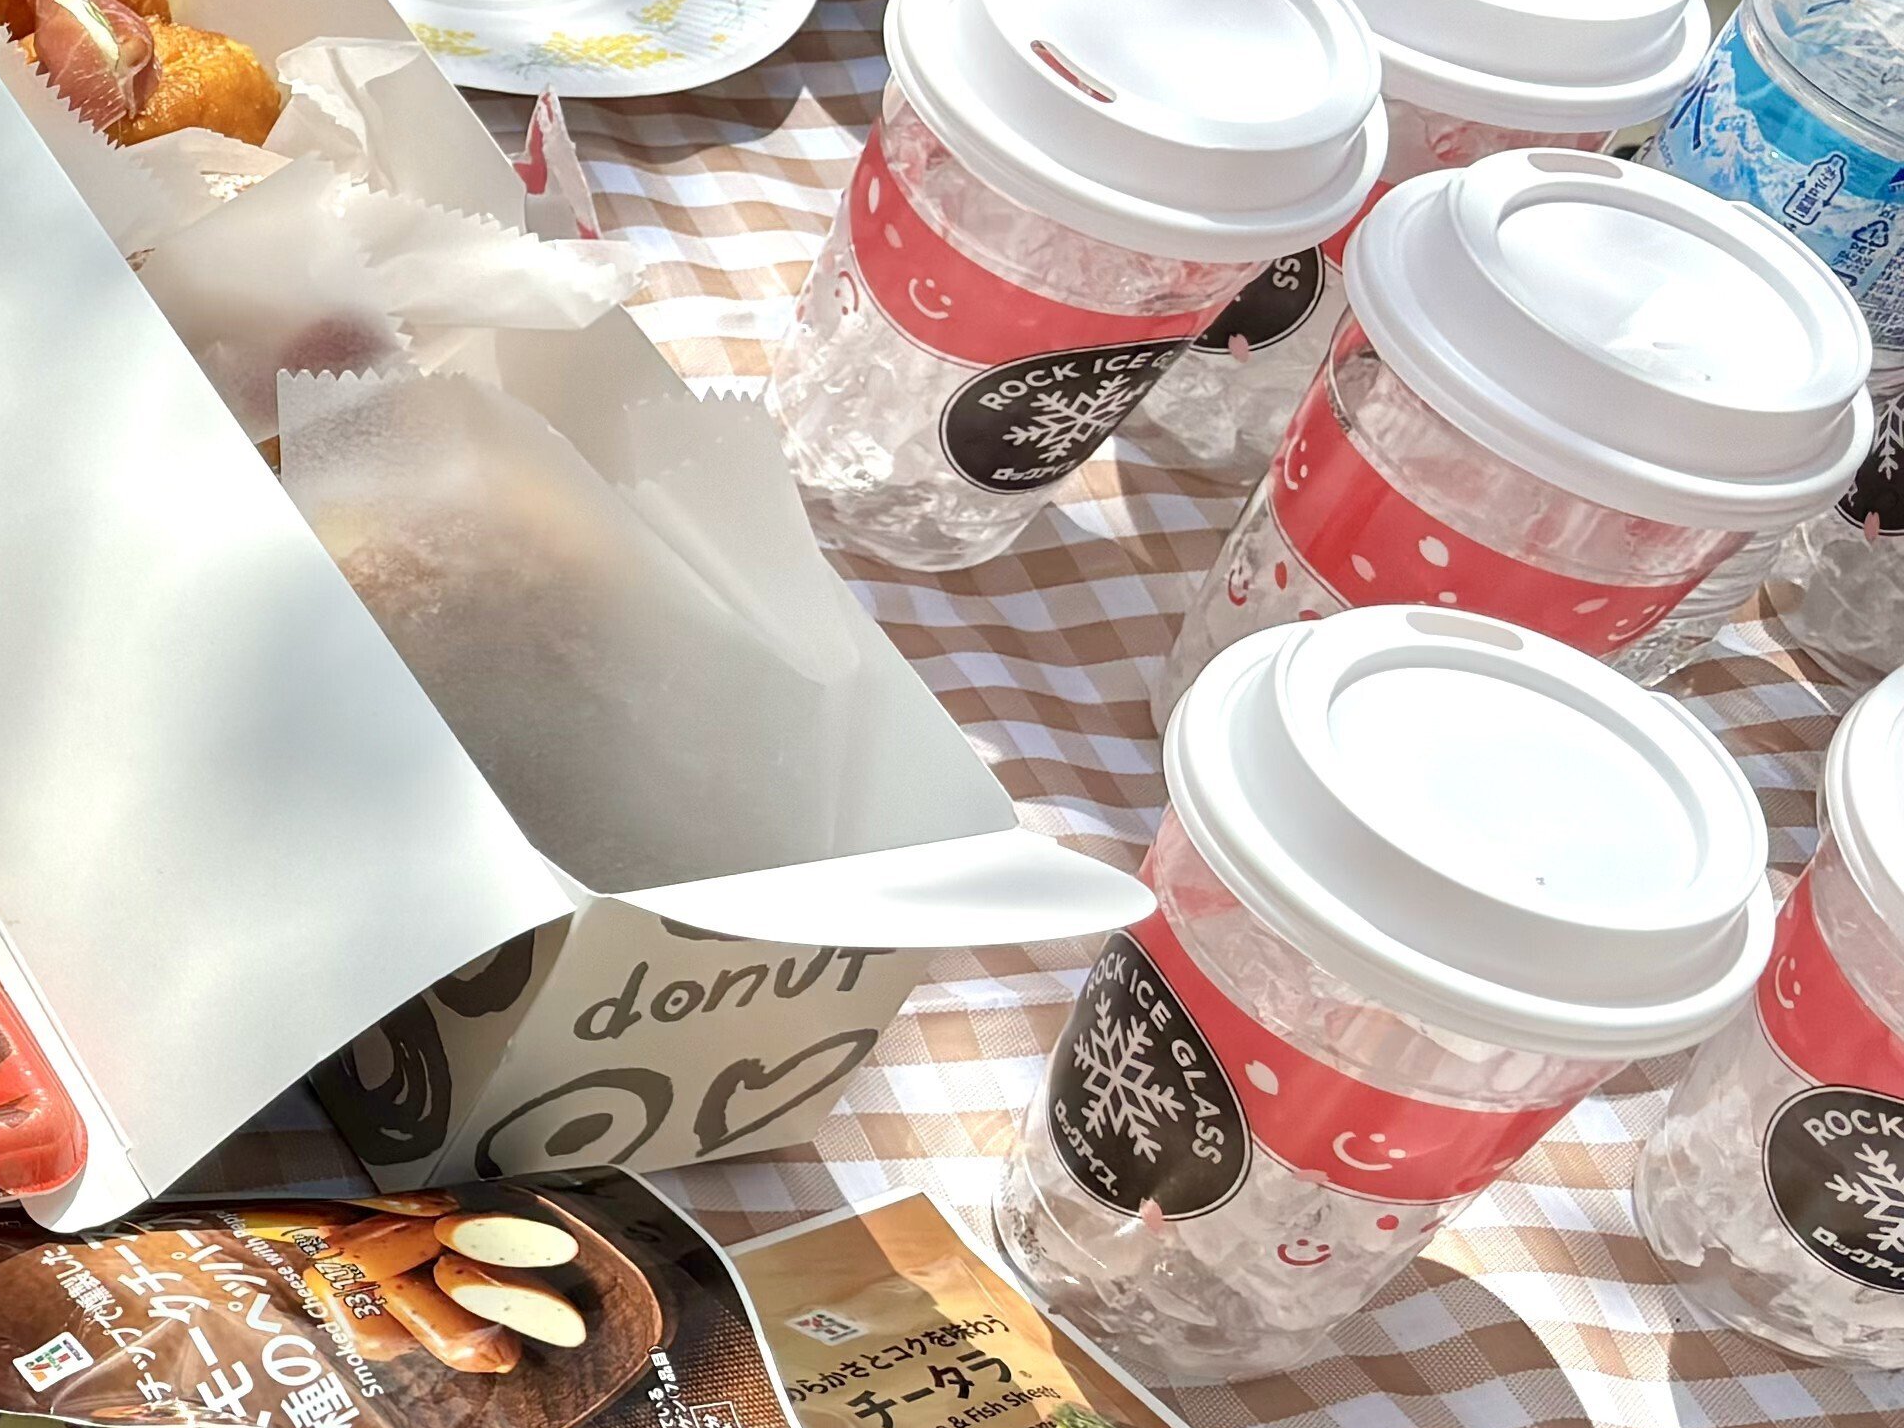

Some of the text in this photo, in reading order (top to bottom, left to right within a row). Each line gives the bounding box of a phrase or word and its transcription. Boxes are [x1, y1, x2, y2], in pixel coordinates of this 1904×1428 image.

[978, 362, 1080, 412] ROCK
[1092, 351, 1154, 374] ICE
[1129, 969, 1172, 1032] ICE
[1171, 1038, 1226, 1165] GLASS
[1802, 1109, 1904, 1147] ROCK
[244, 1235, 284, 1267] with
[277, 1264, 329, 1320] Cheese
[316, 1320, 385, 1399] Smoked
[970, 1399, 1009, 1424] Fish
